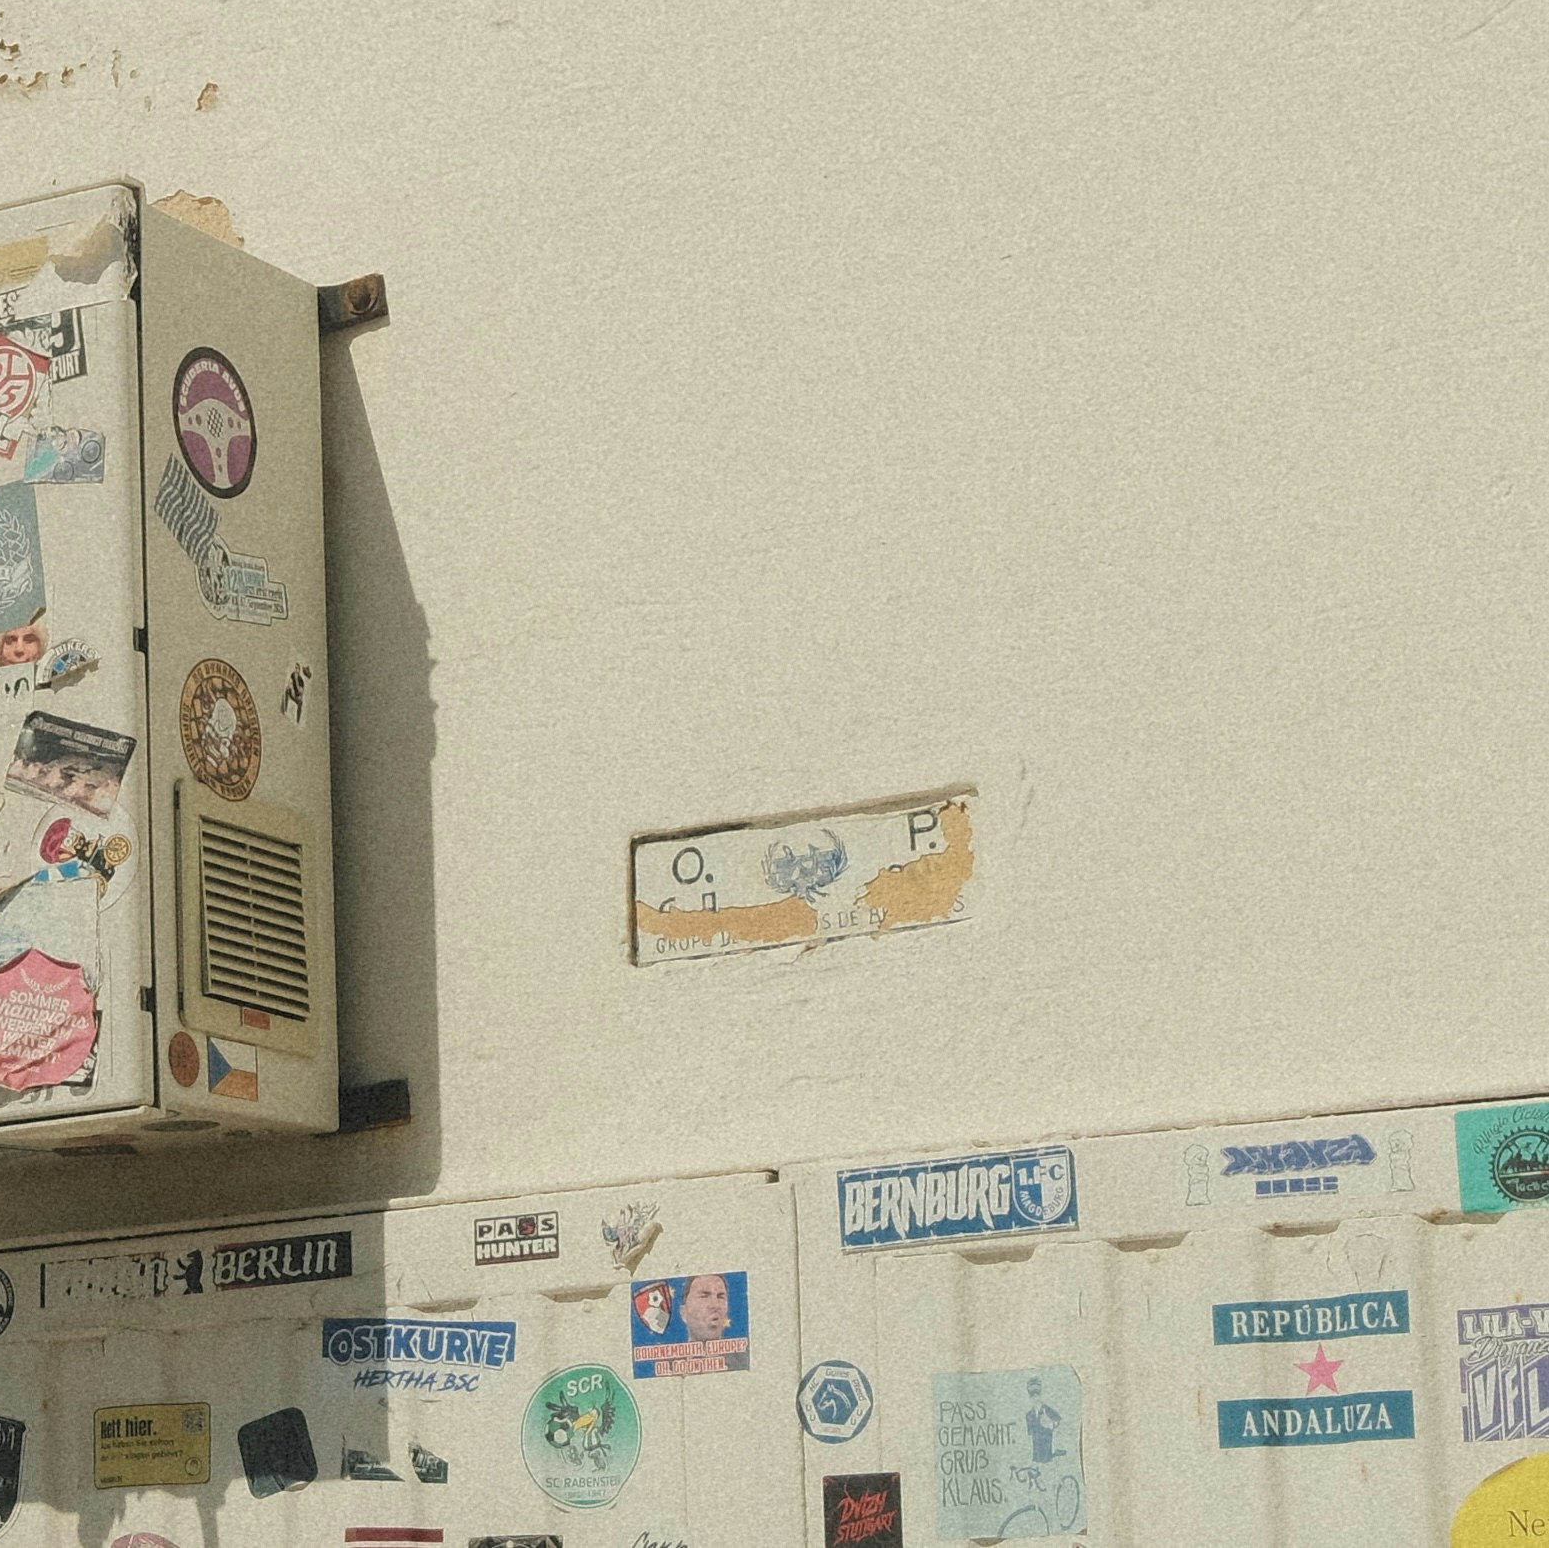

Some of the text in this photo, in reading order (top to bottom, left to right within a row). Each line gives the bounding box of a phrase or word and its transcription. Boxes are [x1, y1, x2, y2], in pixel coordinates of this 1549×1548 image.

[179, 360, 246, 413] SCUDERIA AVUS
[906, 809, 938, 852] P.
[671, 846, 715, 886] O.
[8, 989, 71, 1013] SOMMER
[2, 1030, 56, 1050] WINTER
[844, 1163, 1012, 1241] BERNBURG
[1018, 1185, 1065, 1219] MAGDEBURG
[214, 1238, 338, 1286] BERLIN
[476, 1237, 557, 1260] HUNTER
[1229, 1301, 1400, 1339] REPÚBLICA
[328, 1324, 511, 1370] OSTKURVE
[706, 1338, 748, 1355] EUROPE?
[673, 1360, 687, 1374] GO
[687, 1359, 701, 1373] ON
[701, 1356, 729, 1372] THEN.
[353, 1368, 480, 1393] HERTHA BSC
[566, 1373, 603, 1397] SCR
[939, 1400, 988, 1424] PASS
[1241, 1402, 1394, 1438] ANDALUZA
[100, 1415, 158, 1440] Nett hier.
[938, 1422, 1017, 1448] GEMACHT.
[545, 1477, 560, 1489] SC
[942, 1477, 1009, 1508] KLAUS.
[1507, 1509, 1549, 1538] Ne
